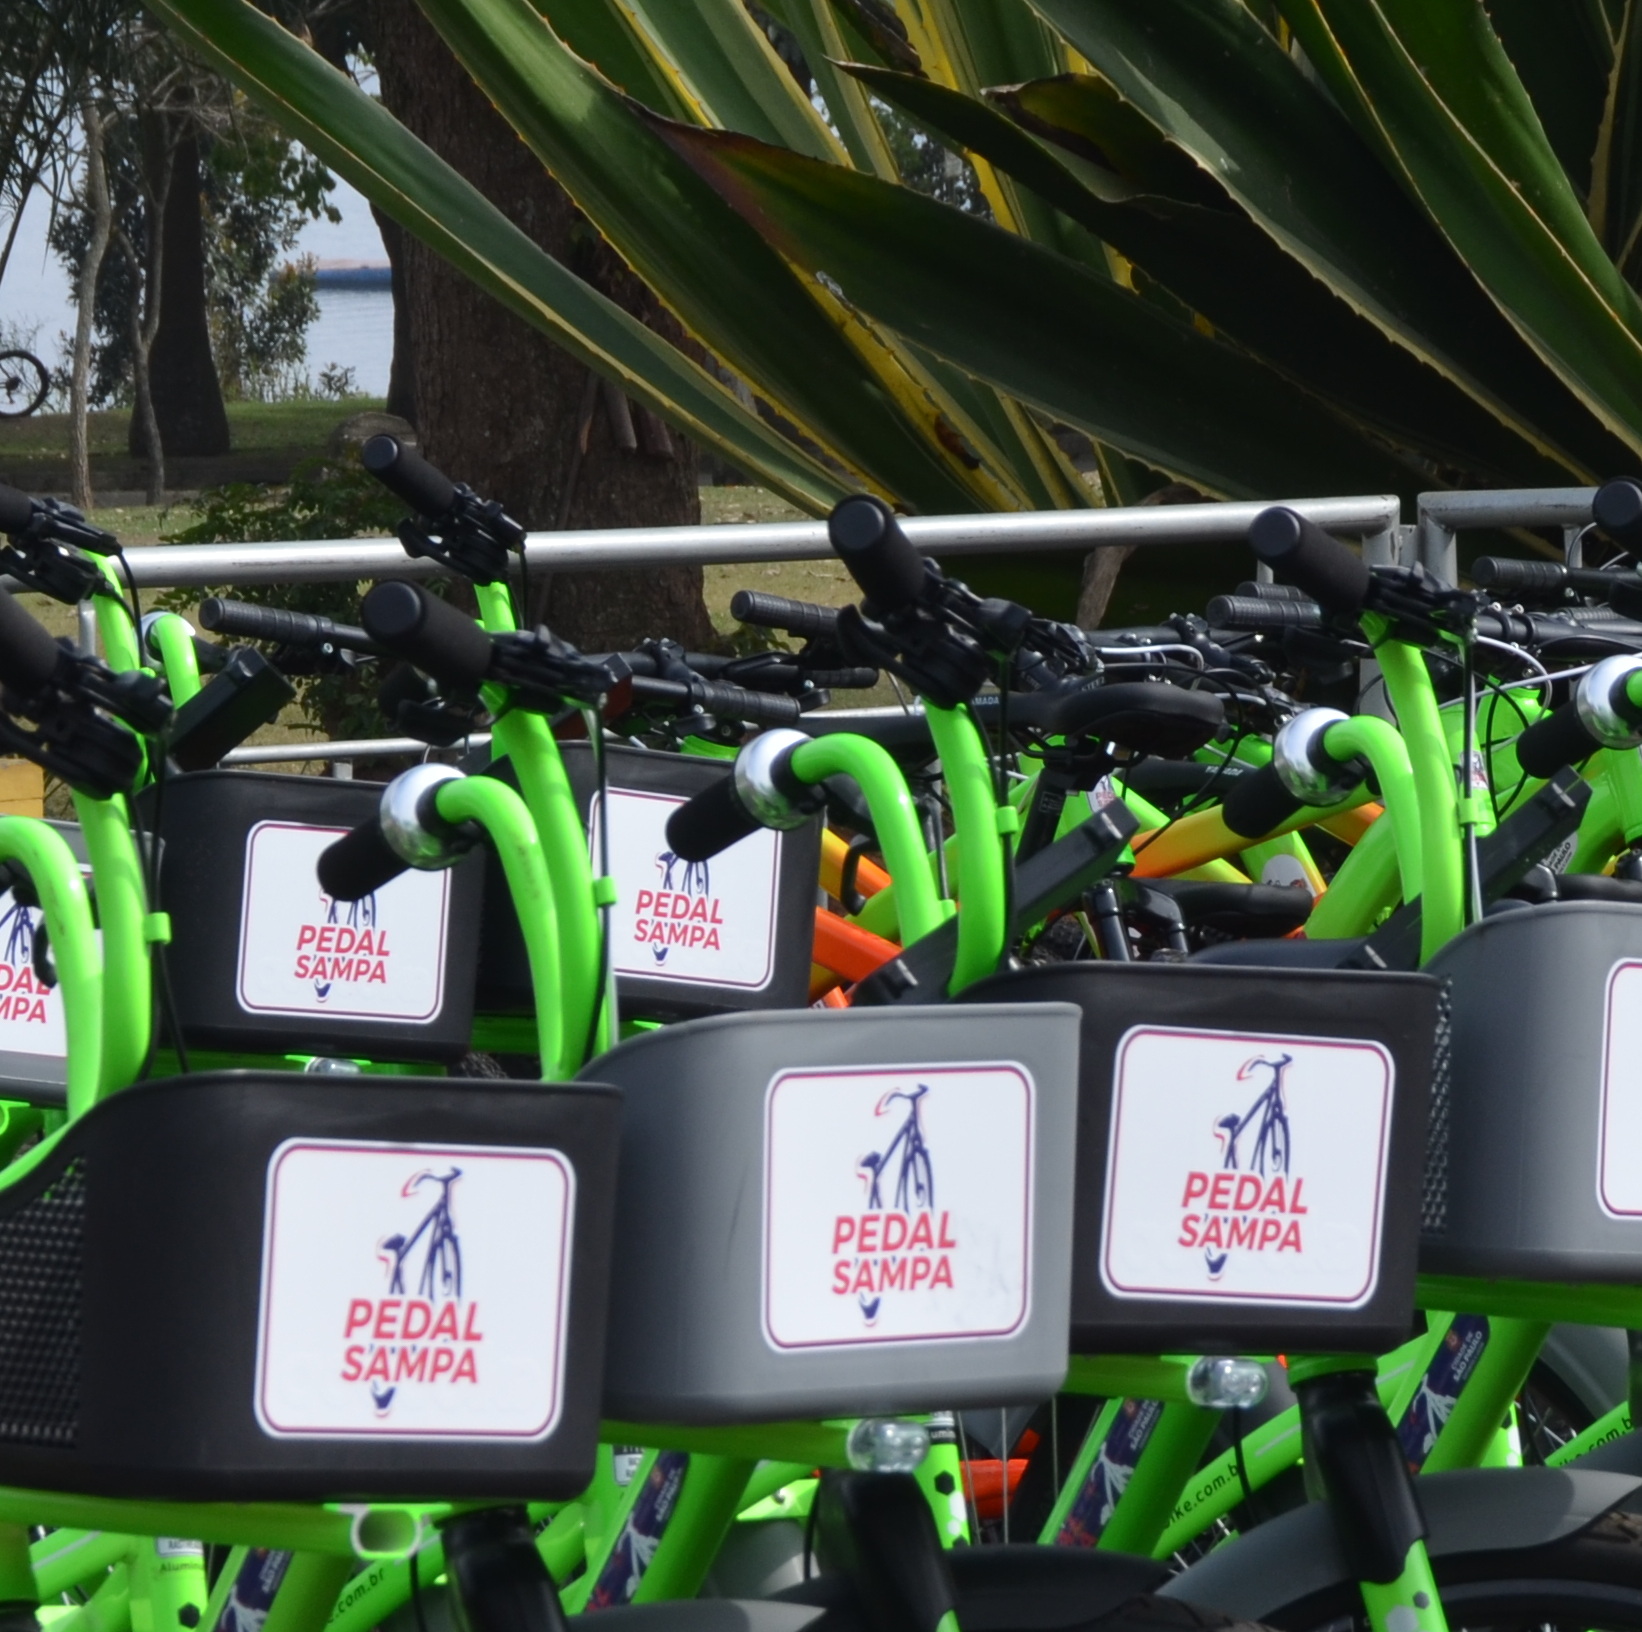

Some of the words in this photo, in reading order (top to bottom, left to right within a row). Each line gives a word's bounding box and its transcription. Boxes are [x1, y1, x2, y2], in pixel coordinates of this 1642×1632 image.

[635, 889, 724, 925] PEDAL
[297, 924, 391, 957] PEDAL
[634, 921, 721, 950] SAMPA
[294, 954, 387, 983] SAMPA
[1182, 1171, 1309, 1215] PEDAL
[832, 1211, 957, 1255] PEDAL
[1178, 1213, 1303, 1253] SAMPA
[832, 1255, 954, 1296] SAMPA
[344, 1298, 483, 1343] PEDAL
[341, 1344, 478, 1384] SAMPA
[1463, 1330, 1483, 1362] PAULO
